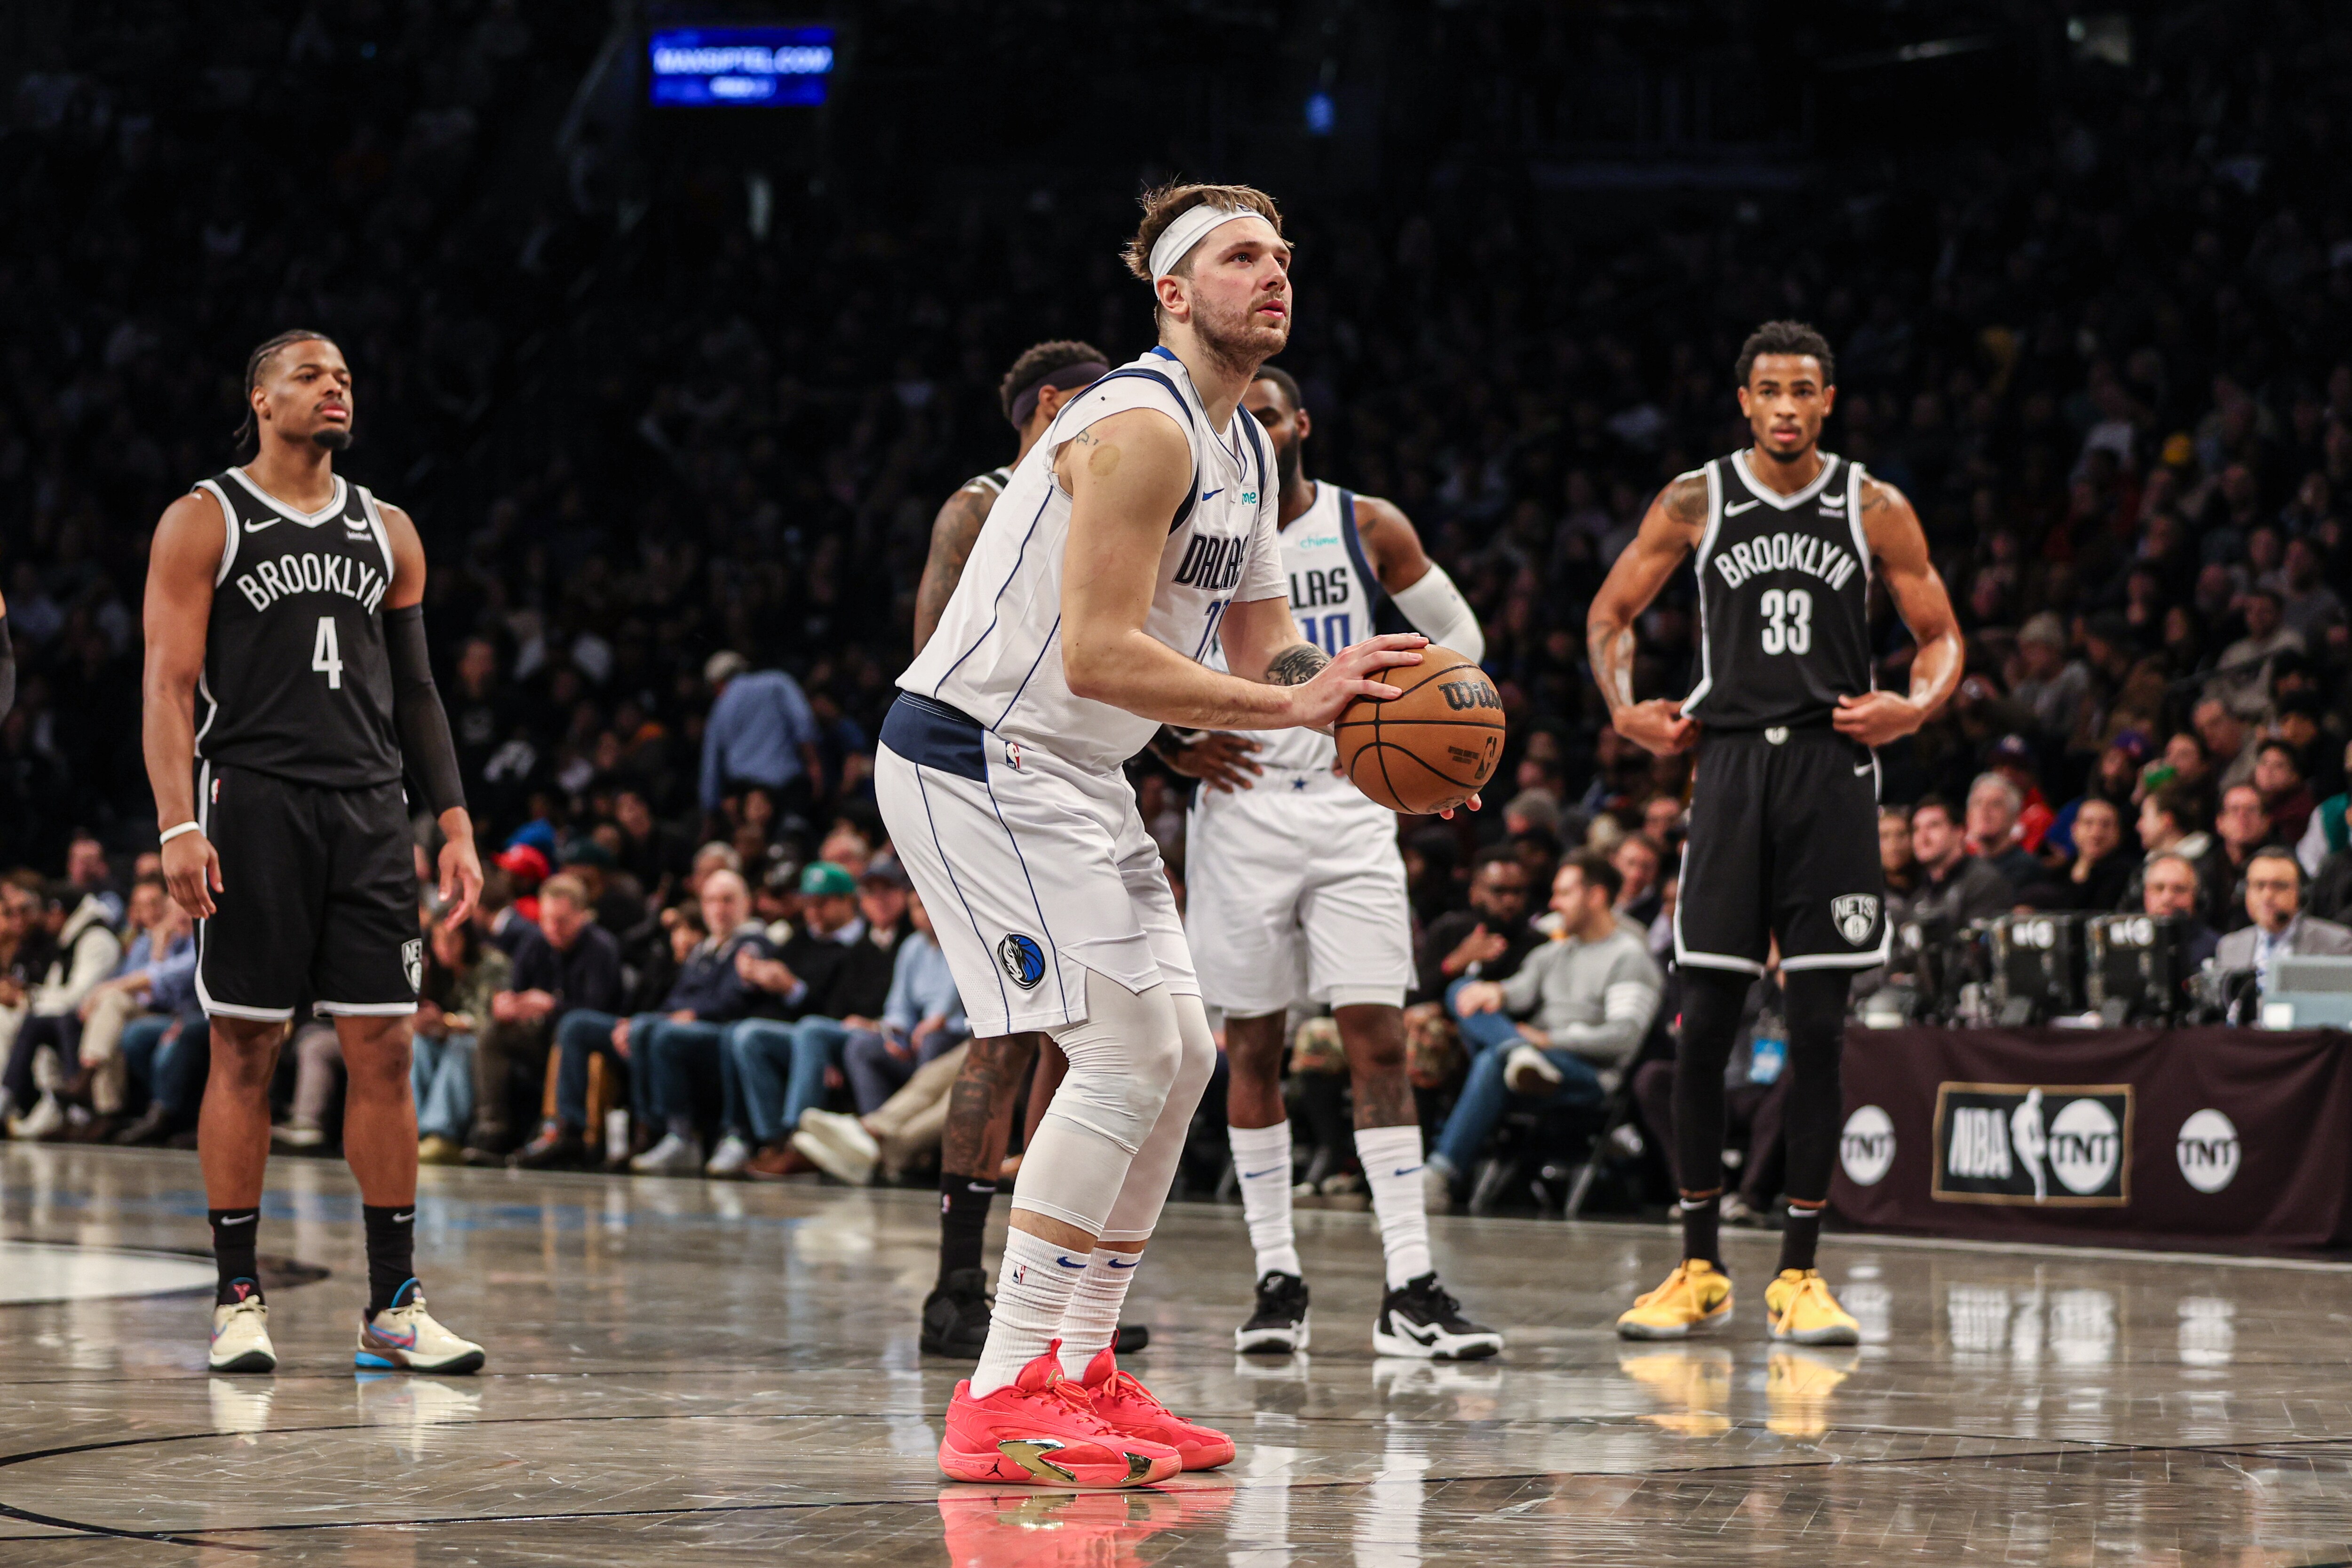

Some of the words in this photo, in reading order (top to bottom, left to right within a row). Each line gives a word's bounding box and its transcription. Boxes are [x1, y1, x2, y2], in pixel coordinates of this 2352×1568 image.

[237, 552, 387, 615] BROOKLYN
[1289, 567, 1349, 610] LAS
[1714, 532, 1857, 591] BROOKLYN
[1761, 589, 1812, 655] 33
[312, 616, 343, 690] 4
[1835, 896, 1877, 920] NETS
[1843, 1133, 1892, 1160] TNT
[1948, 1107, 2012, 1178] NBA
[2050, 1132, 2117, 1163] TNT
[2178, 1137, 2236, 1167] TNT
